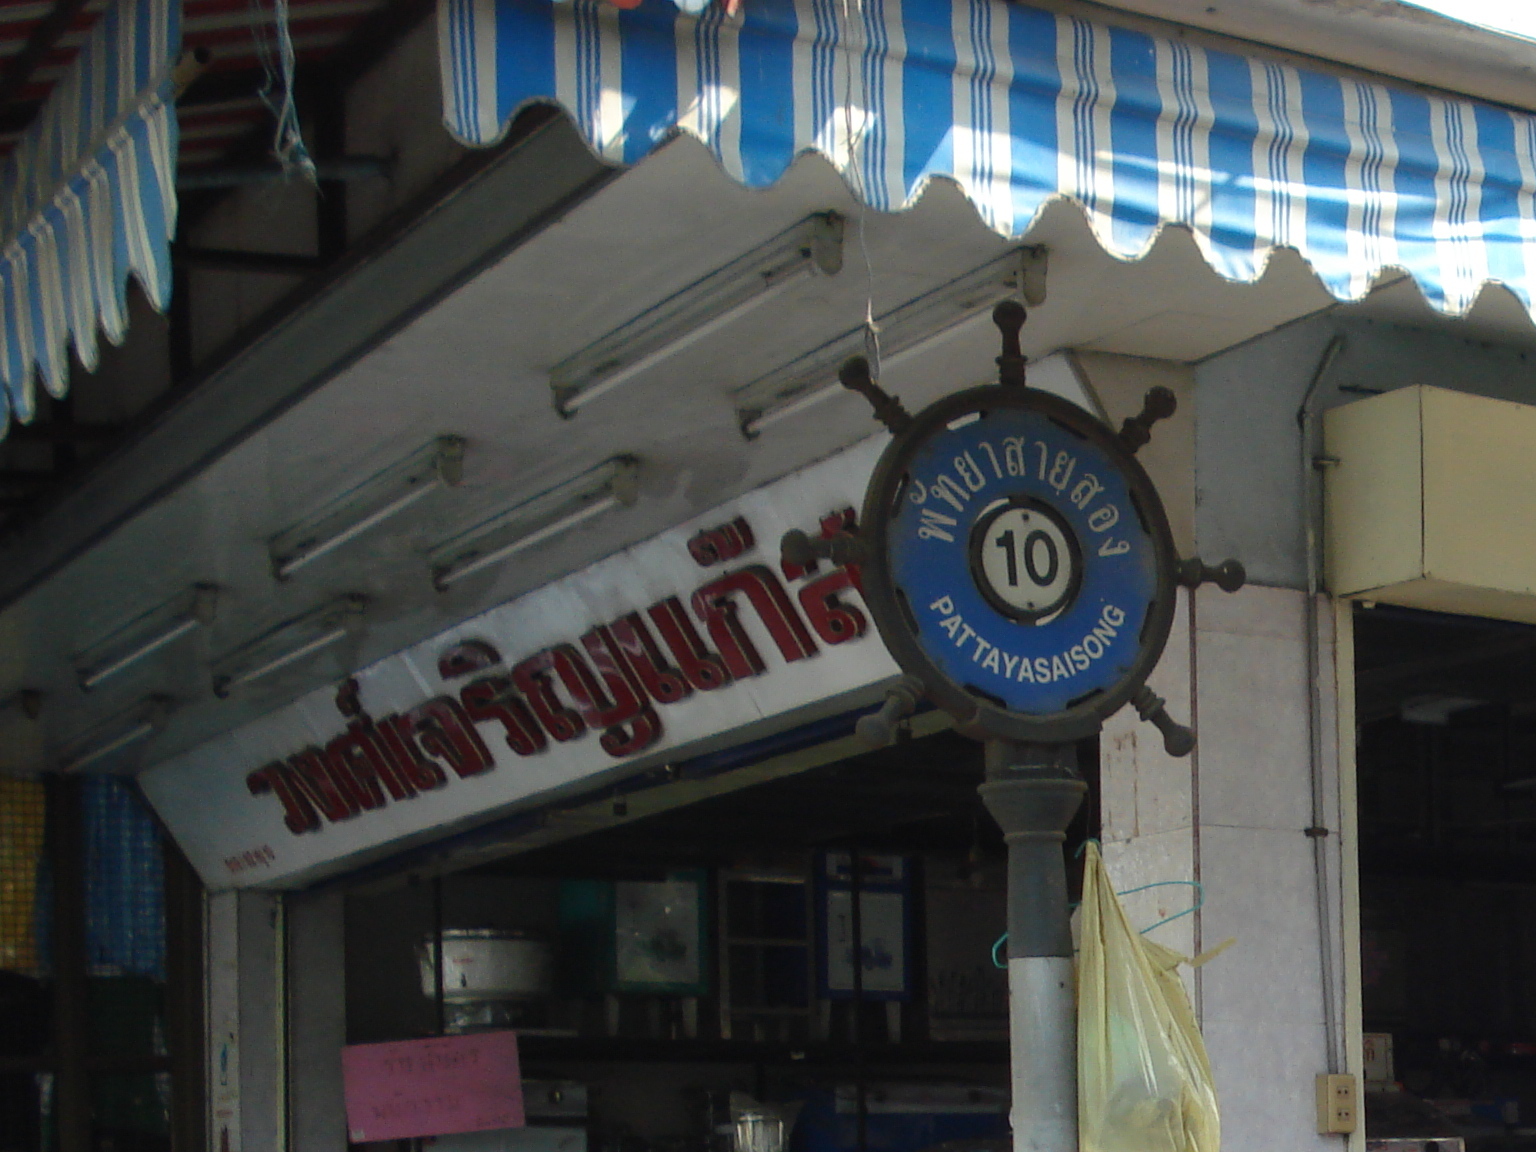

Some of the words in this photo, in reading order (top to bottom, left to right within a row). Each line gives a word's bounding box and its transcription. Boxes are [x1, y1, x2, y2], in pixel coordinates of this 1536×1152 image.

[918, 437, 1130, 557] พัทยาสายสอง
[995, 529, 1059, 587] 10
[929, 595, 1126, 684] PATTAYASAISONG
